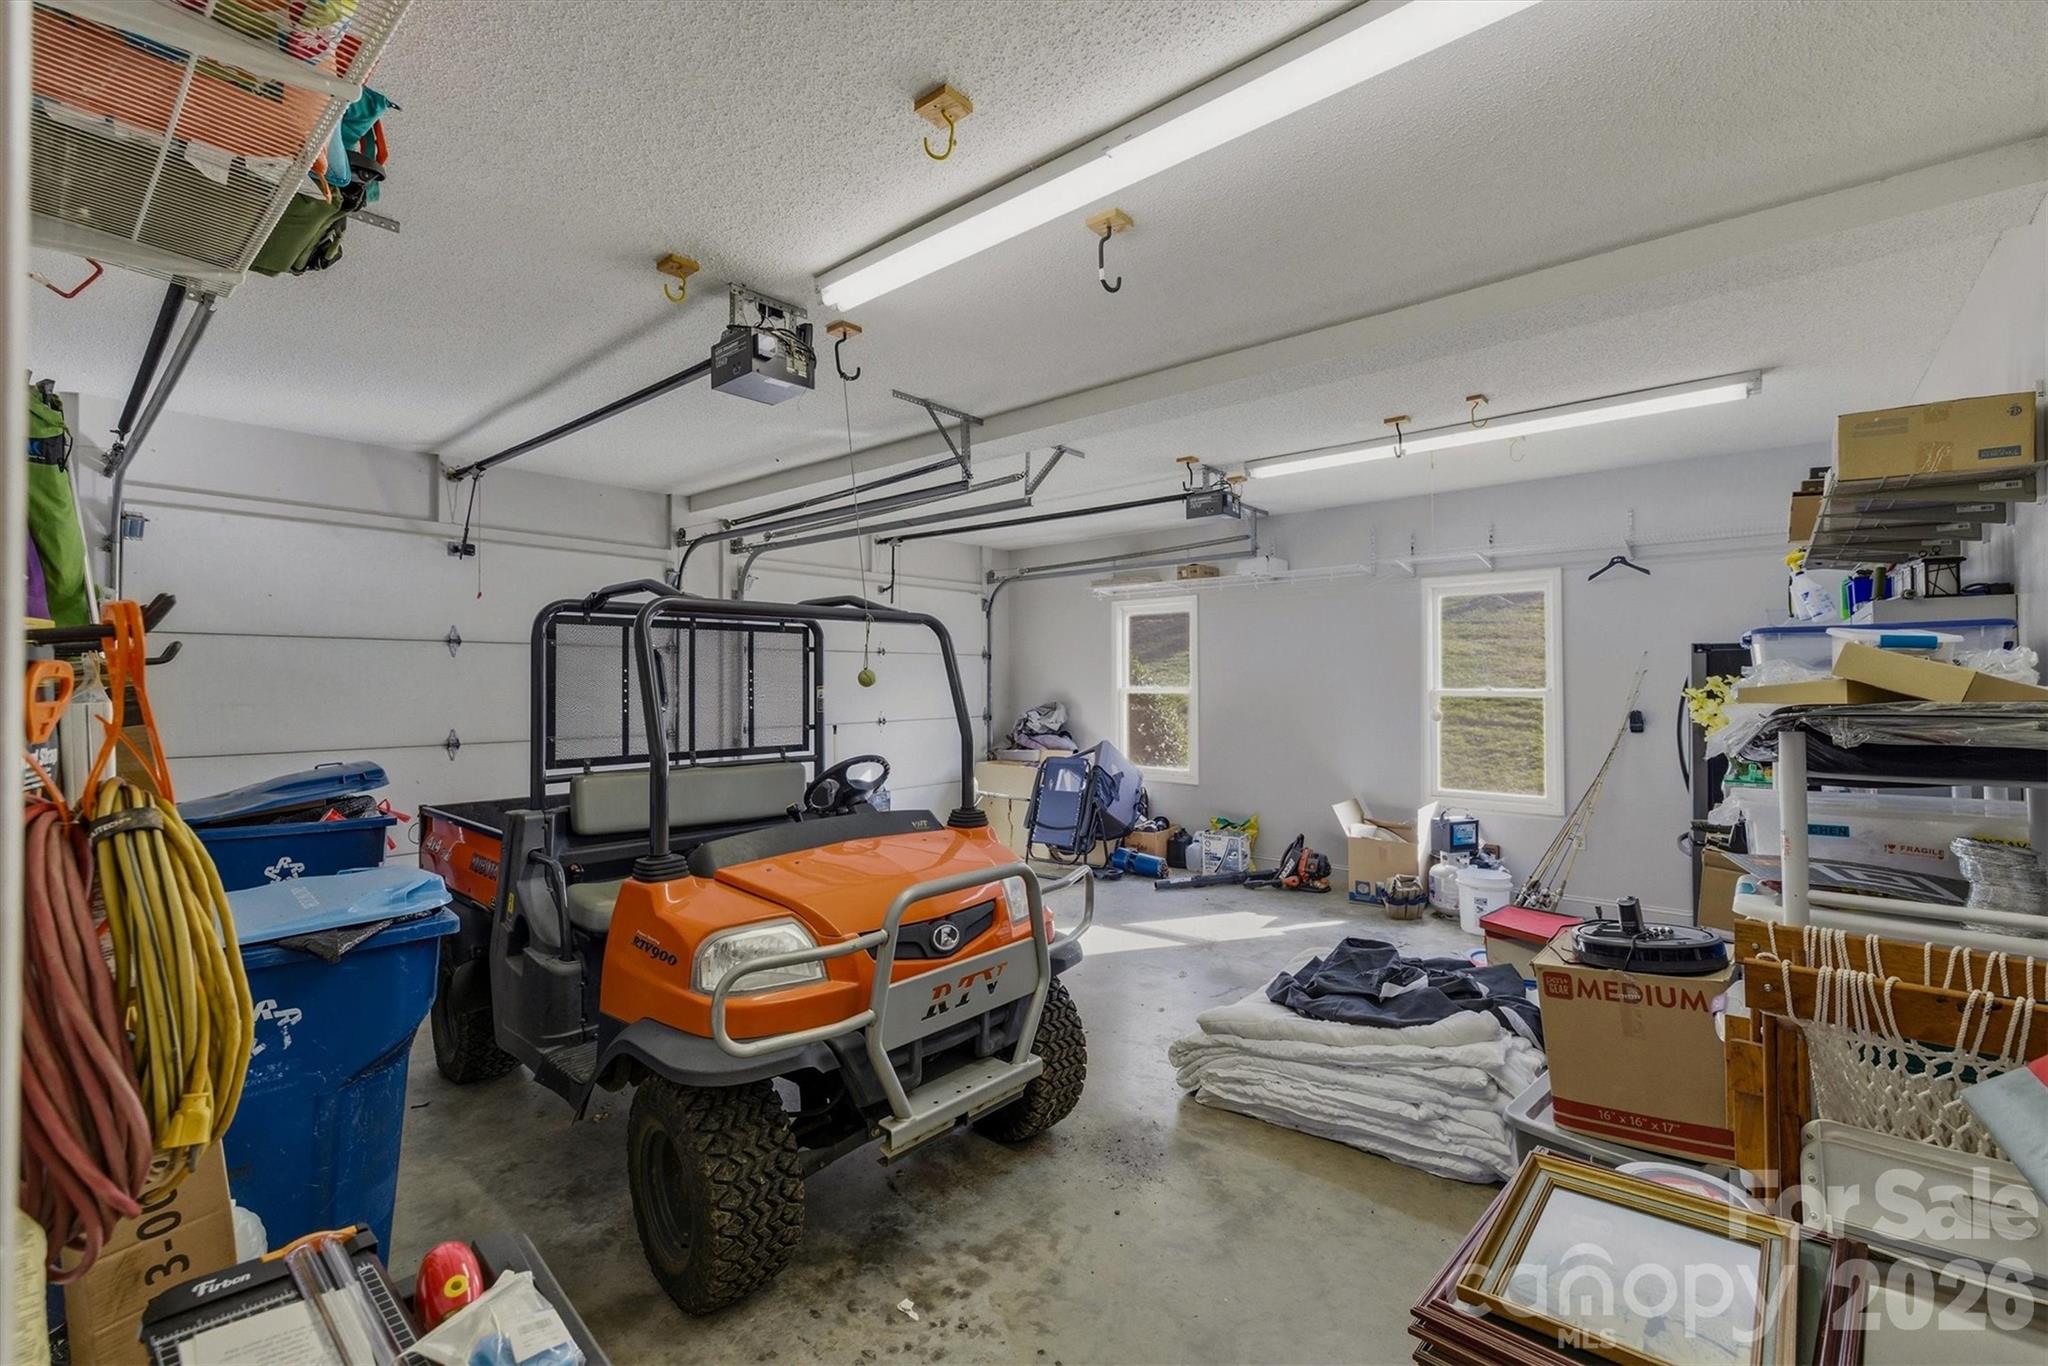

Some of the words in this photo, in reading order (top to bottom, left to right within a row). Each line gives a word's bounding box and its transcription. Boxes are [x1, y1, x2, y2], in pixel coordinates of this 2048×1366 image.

[1900, 845, 1944, 856] FRAGILE
[633, 936, 677, 966] RTV900
[920, 962, 1008, 1021] RTV
[1576, 977, 1709, 1013] MEDIUM
[191, 1272, 252, 1298] Firbon
